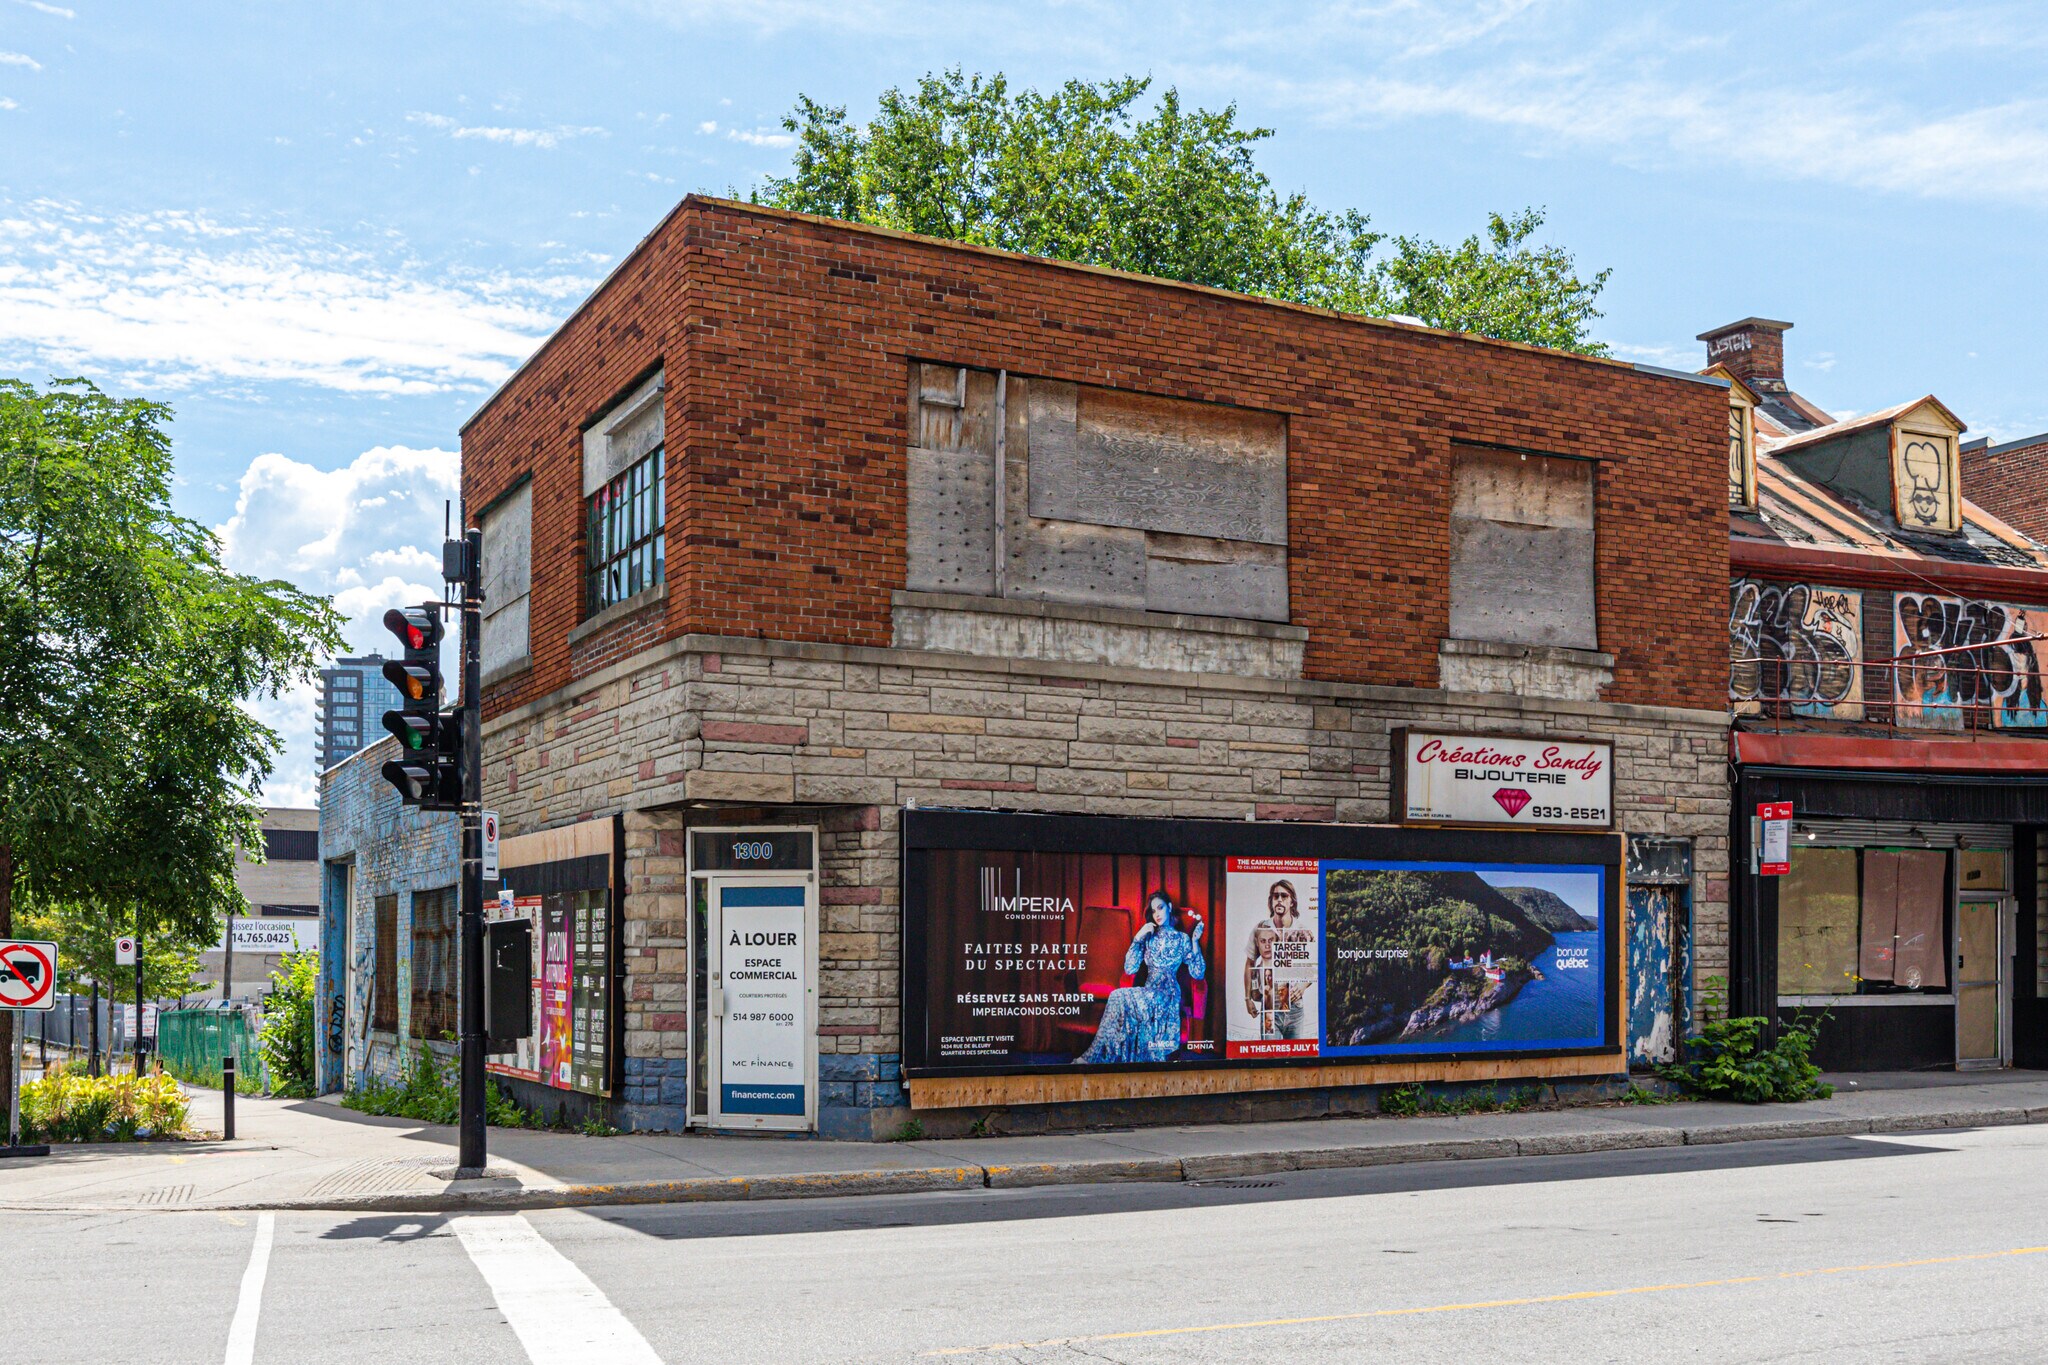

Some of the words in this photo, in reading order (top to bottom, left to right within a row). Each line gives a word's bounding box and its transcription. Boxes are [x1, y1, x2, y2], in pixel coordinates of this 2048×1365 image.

[1416, 739, 1527, 768] Créations
[1533, 746, 1603, 781] Sandy
[1454, 768, 1567, 785] BIJOUTERIE
[1532, 805, 1606, 820] 933-2521
[732, 842, 773, 859] 1300
[994, 896, 1075, 912] IMPERIA
[232, 933, 290, 943] 14.765.0425
[729, 929, 742, 946] À
[745, 932, 798, 946] LOUER
[964, 943, 1023, 954] FAITES
[1030, 943, 1088, 954] PARTIE
[1273, 943, 1308, 952] TARGET
[1273, 951, 1310, 960] NUMBER
[1337, 946, 1374, 962] bonjour
[1374, 946, 1408, 960] surprise
[744, 958, 782, 968] ESPACE
[965, 960, 987, 971] DU
[994, 960, 1087, 971] SPECTACLE
[1273, 960, 1292, 968] ONE
[1556, 957, 1589, 970] québec
[729, 971, 798, 980] COMMERCIAL
[956, 992, 1016, 1004] RÉSERVEZ
[1018, 994, 1049, 1003] SANS
[1052, 993, 1095, 1002] TARDER
[972, 1006, 1081, 1017] IMPERIACONDOS.COM
[732, 1013, 748, 1021] 514
[750, 1013, 766, 1021] 987
[768, 1013, 794, 1022] 6000
[1240, 1045, 1248, 1054] IN
[1250, 1044, 1291, 1053] THEATRES
[1292, 1044, 1310, 1052] JULY
[731, 1090, 796, 1100] financemc.com
